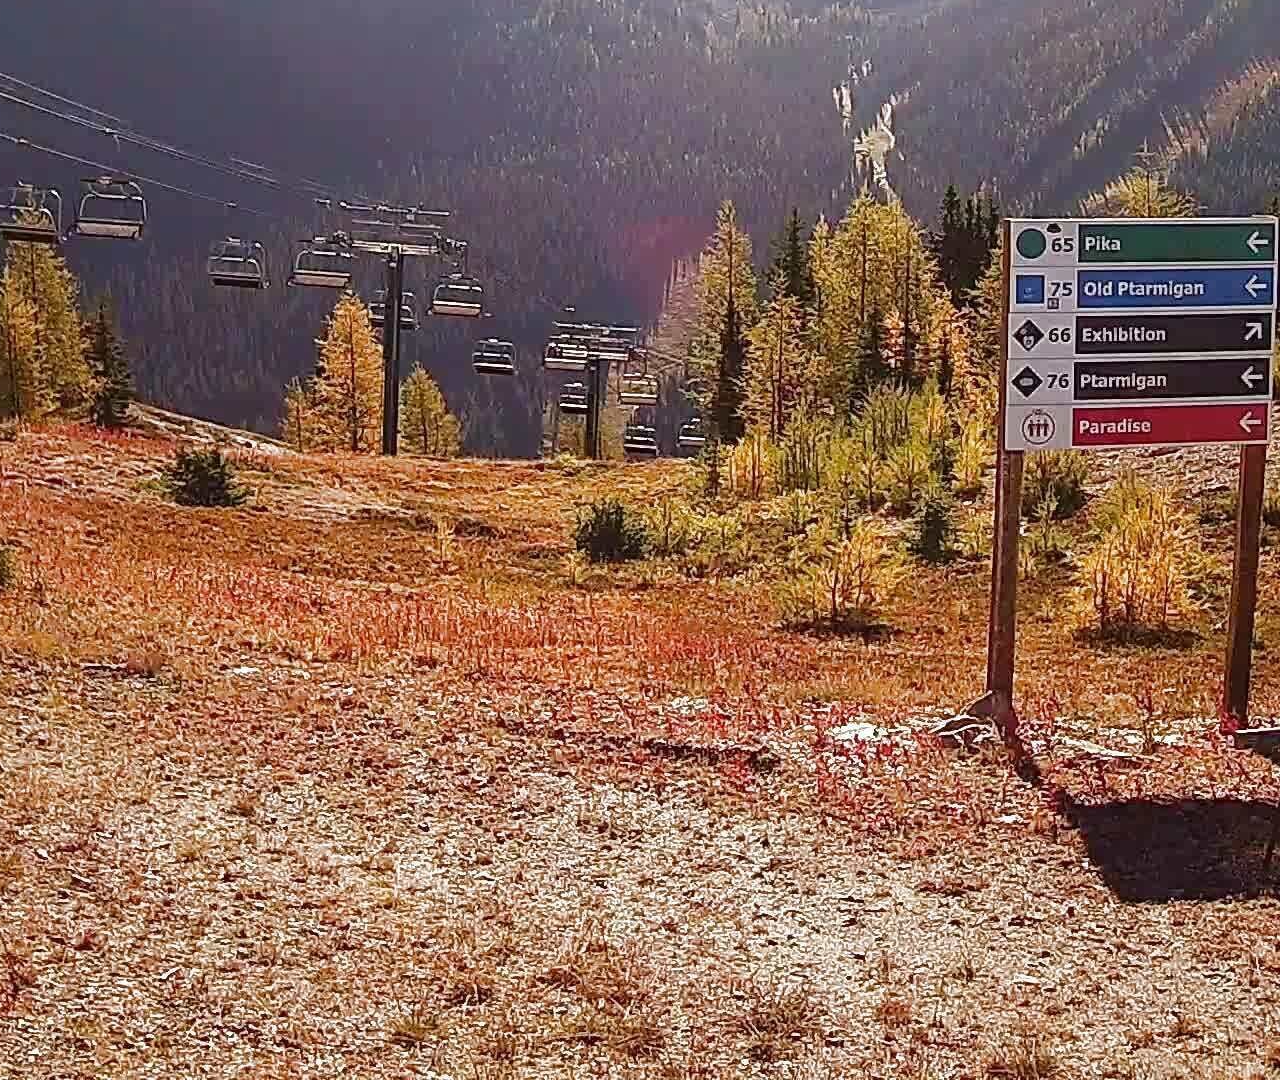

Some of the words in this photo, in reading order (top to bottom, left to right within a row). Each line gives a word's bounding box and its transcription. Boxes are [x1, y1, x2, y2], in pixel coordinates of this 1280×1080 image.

[1051, 237, 1074, 253] 65
[1085, 236, 1121, 252] Pika
[1050, 282, 1073, 296] 75
[1083, 281, 1112, 297] Old
[1118, 281, 1204, 299] Ptarmigan
[1048, 327, 1071, 343] 66
[1082, 326, 1166, 343] Exhibition
[1047, 373, 1069, 389] 76
[1080, 372, 1167, 390] Ptarmigan
[1079, 417, 1151, 435] Paradise
